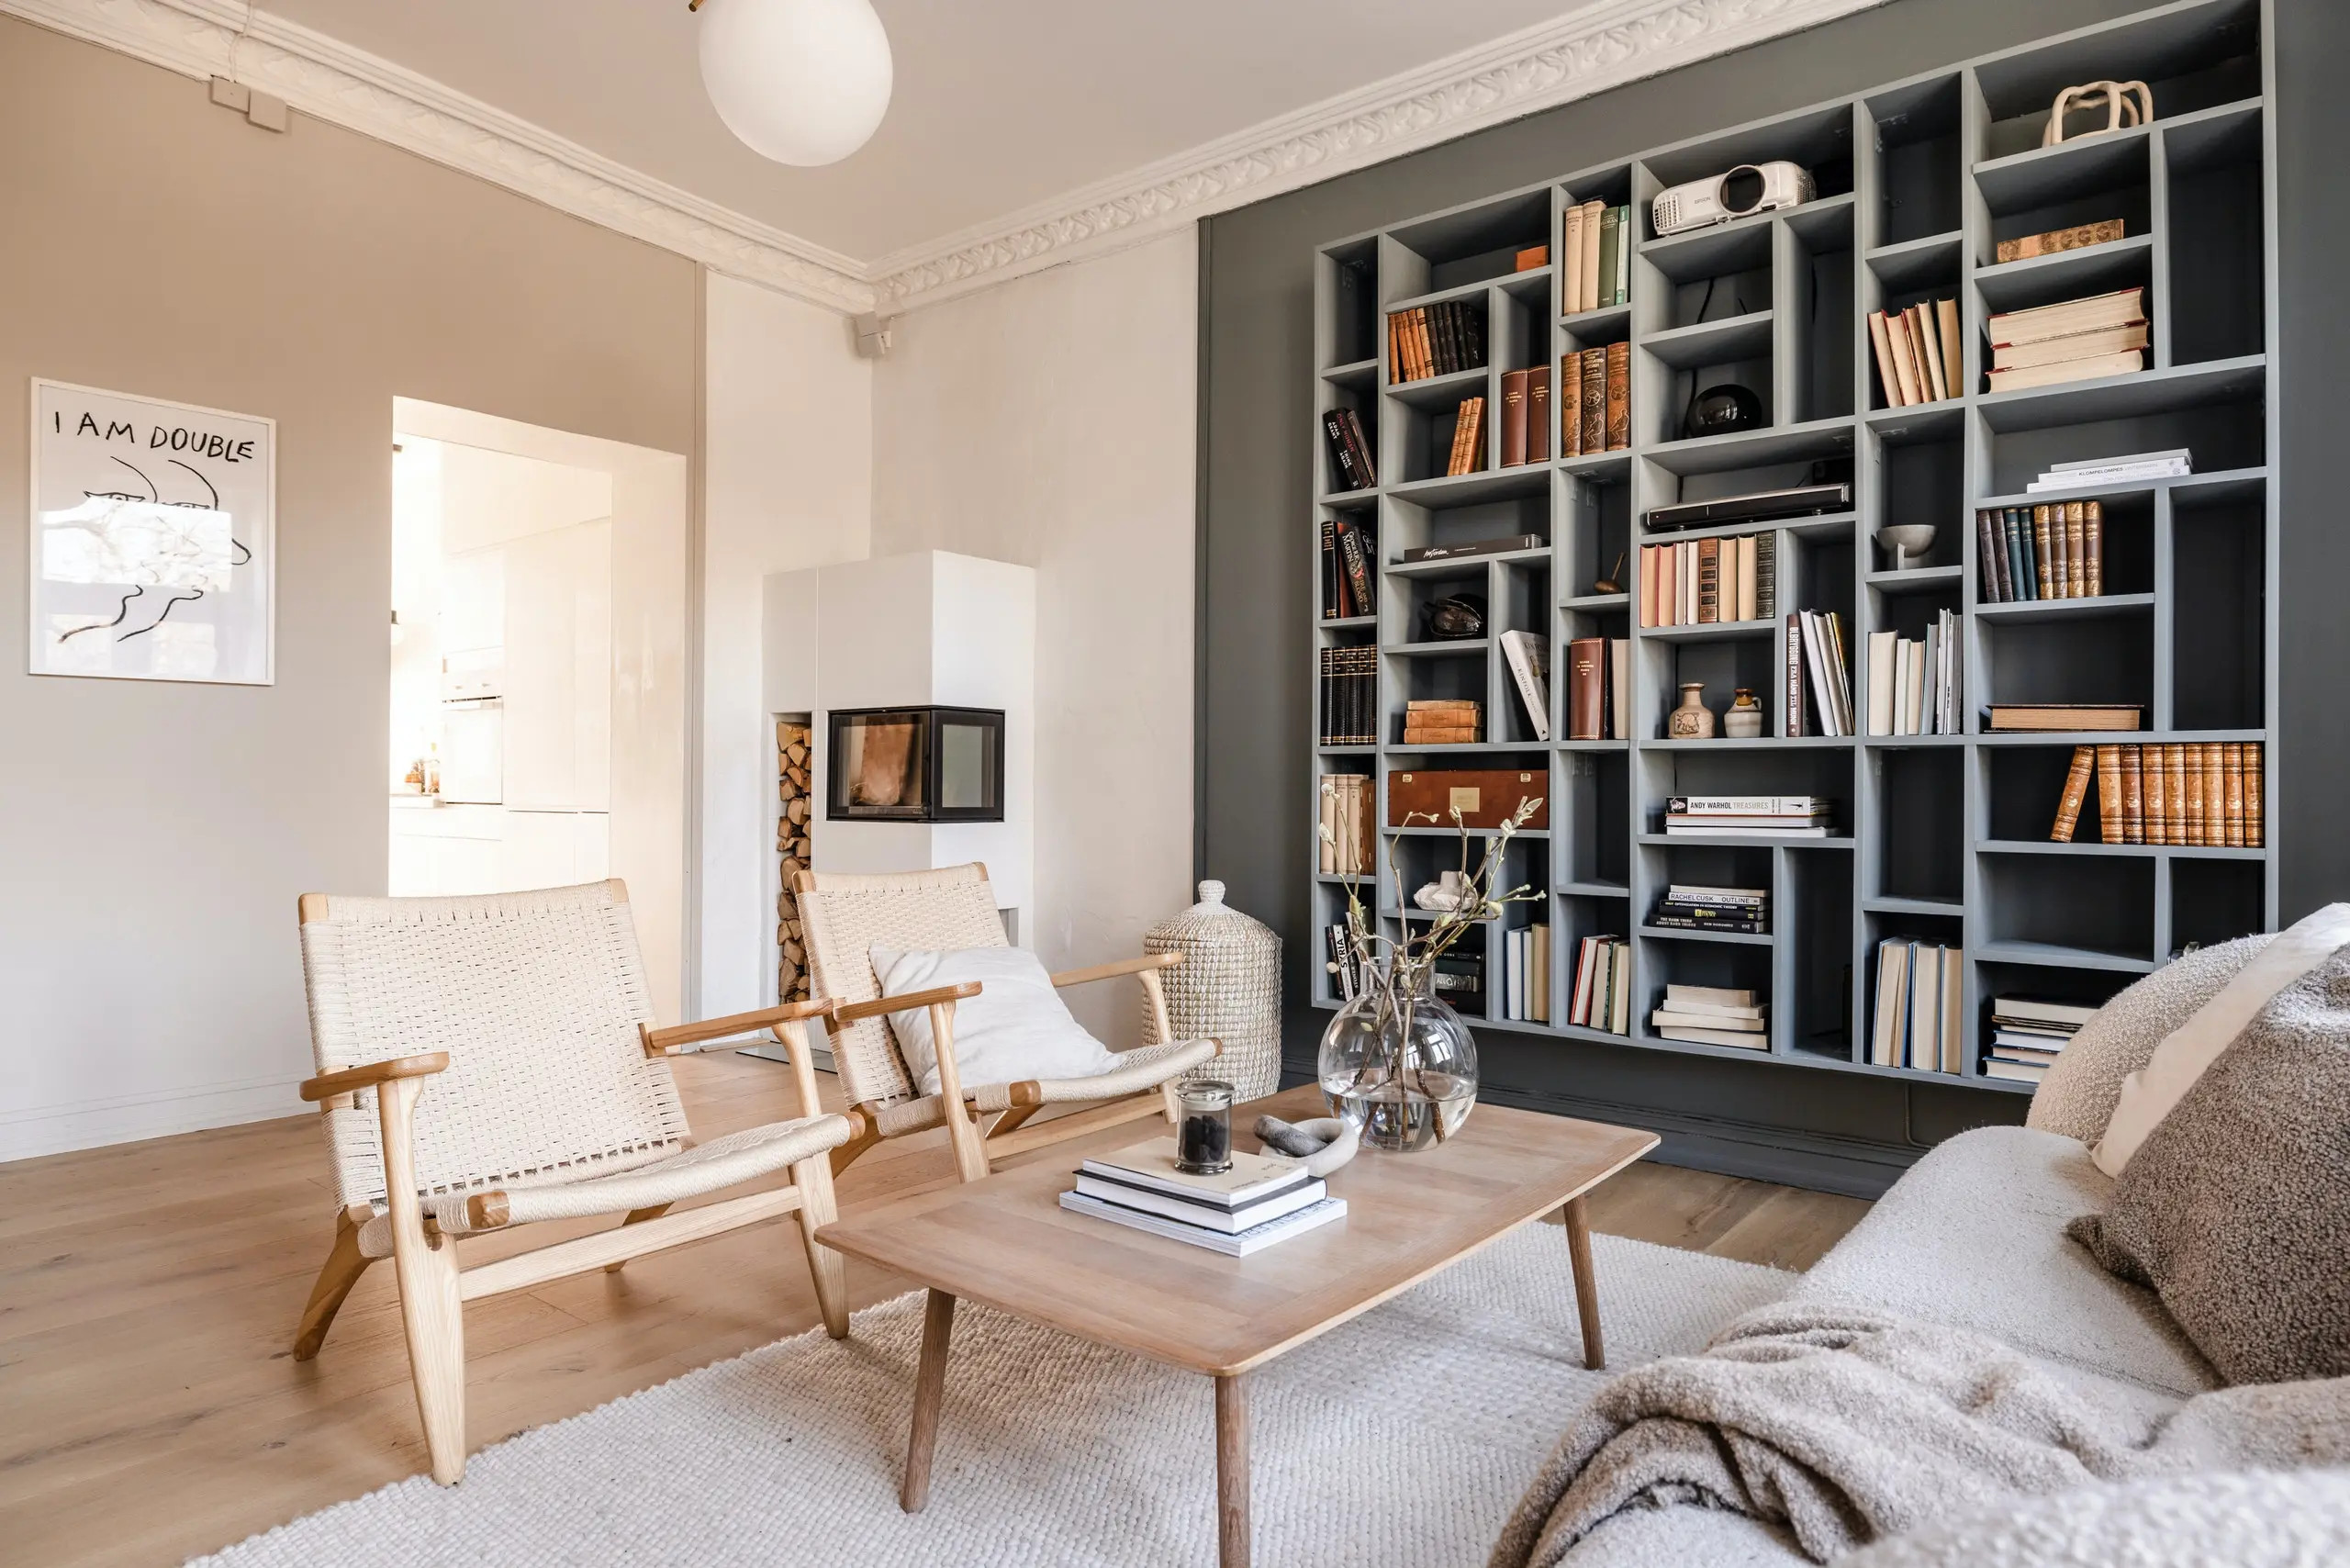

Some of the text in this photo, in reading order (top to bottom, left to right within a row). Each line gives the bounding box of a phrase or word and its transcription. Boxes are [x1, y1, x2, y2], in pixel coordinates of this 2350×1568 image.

[54, 410, 255, 463] I AM DOUBLE
[1690, 801, 1707, 810] ANDY
[1707, 801, 1732, 810] WARHOL
